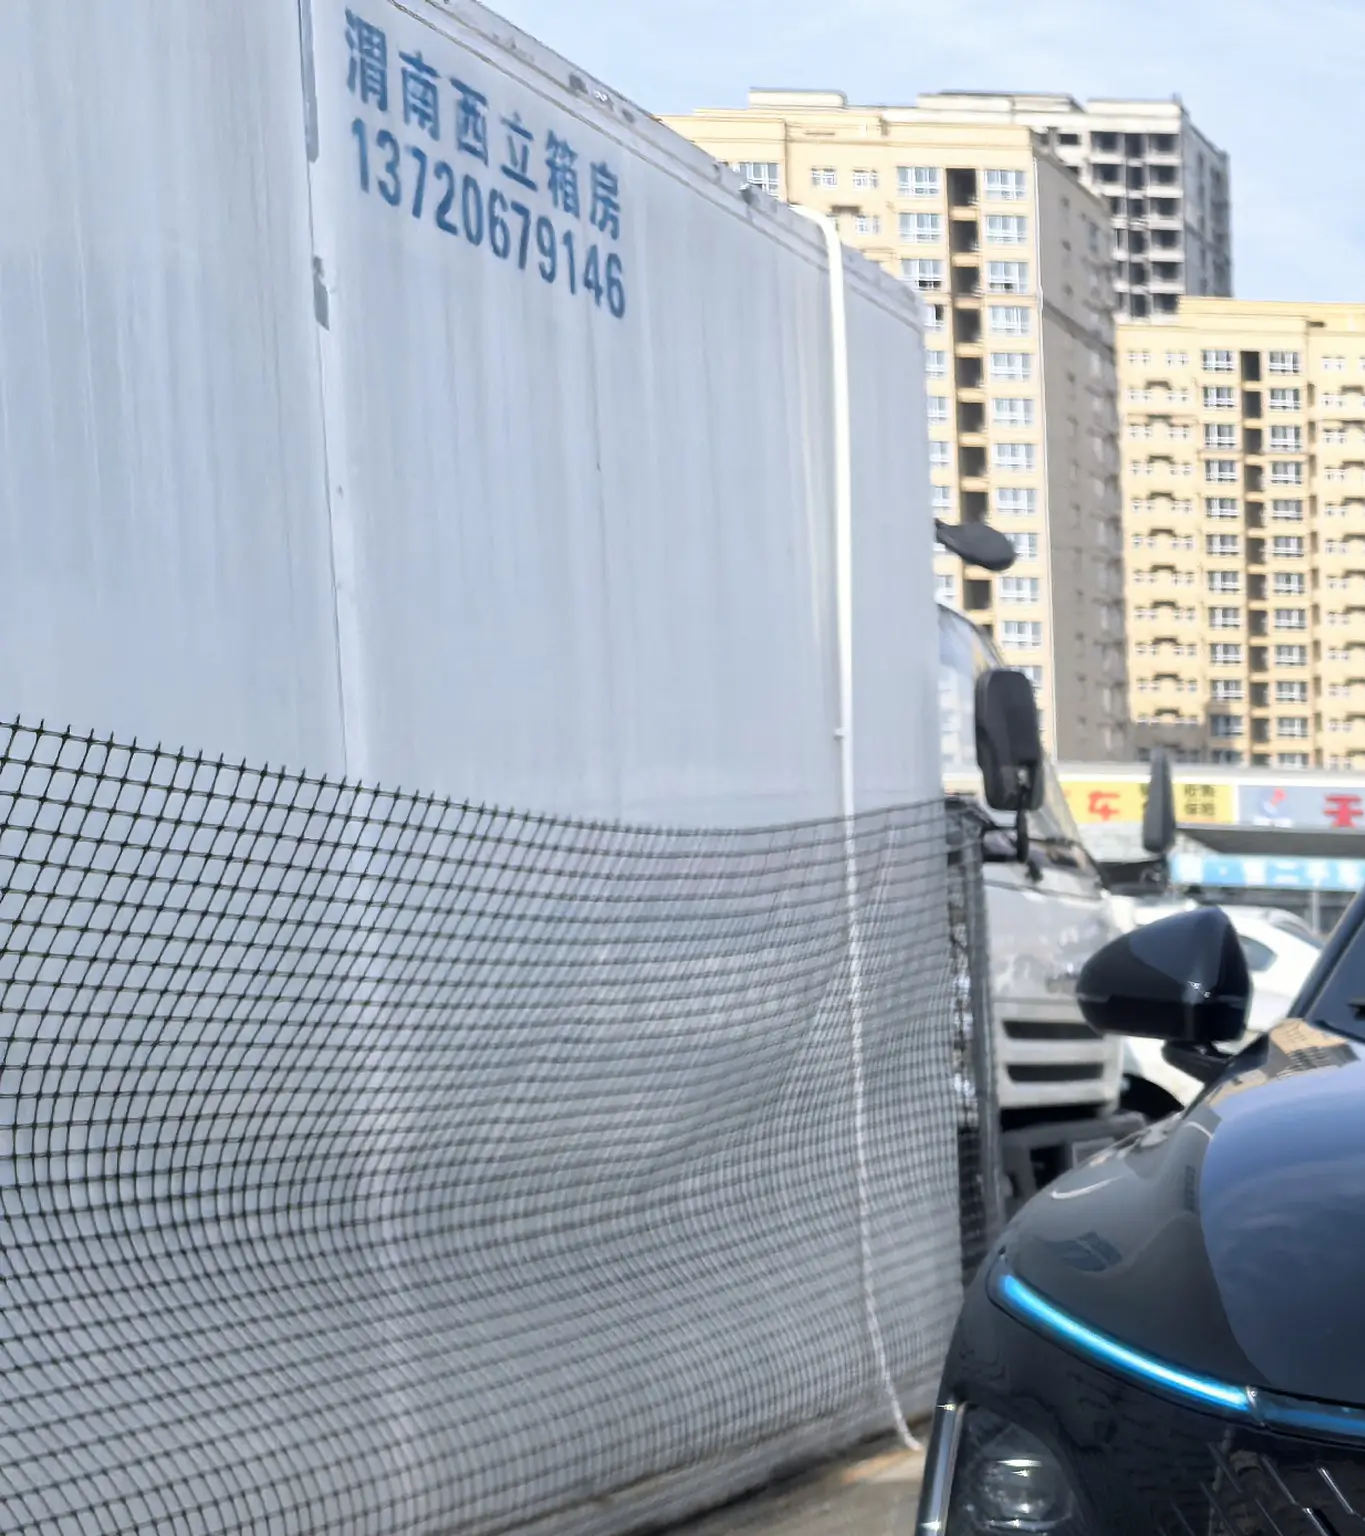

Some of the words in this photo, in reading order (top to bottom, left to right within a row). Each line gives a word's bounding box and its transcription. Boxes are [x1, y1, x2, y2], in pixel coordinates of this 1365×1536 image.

[344, 8, 621, 241] 渭南西立箱房
[350, 116, 626, 320] 13720679146
